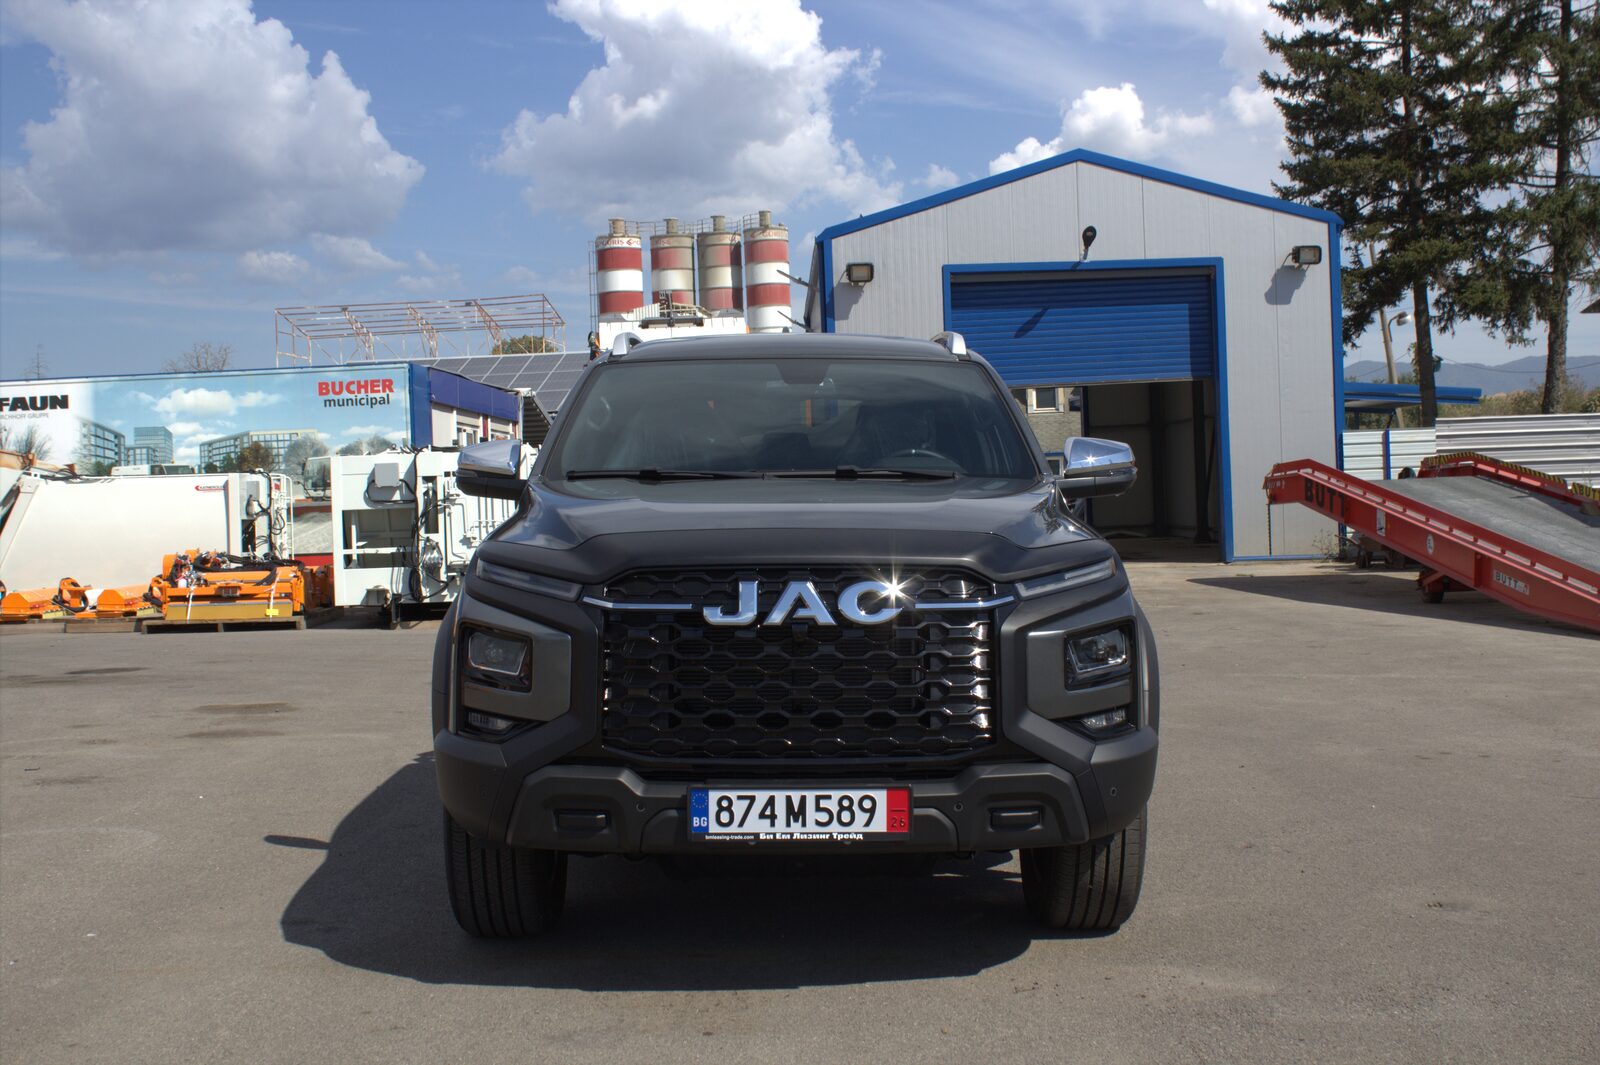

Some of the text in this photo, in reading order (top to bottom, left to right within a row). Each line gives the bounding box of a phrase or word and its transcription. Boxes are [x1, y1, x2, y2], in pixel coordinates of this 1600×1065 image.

[318, 379, 394, 396] BUCHER
[0, 395, 69, 411] FAUN
[324, 394, 390, 408] municipal
[703, 581, 903, 625] JAC
[693, 817, 708, 827] BG
[891, 817, 906, 828] 26
[832, 832, 864, 840] Трейд
